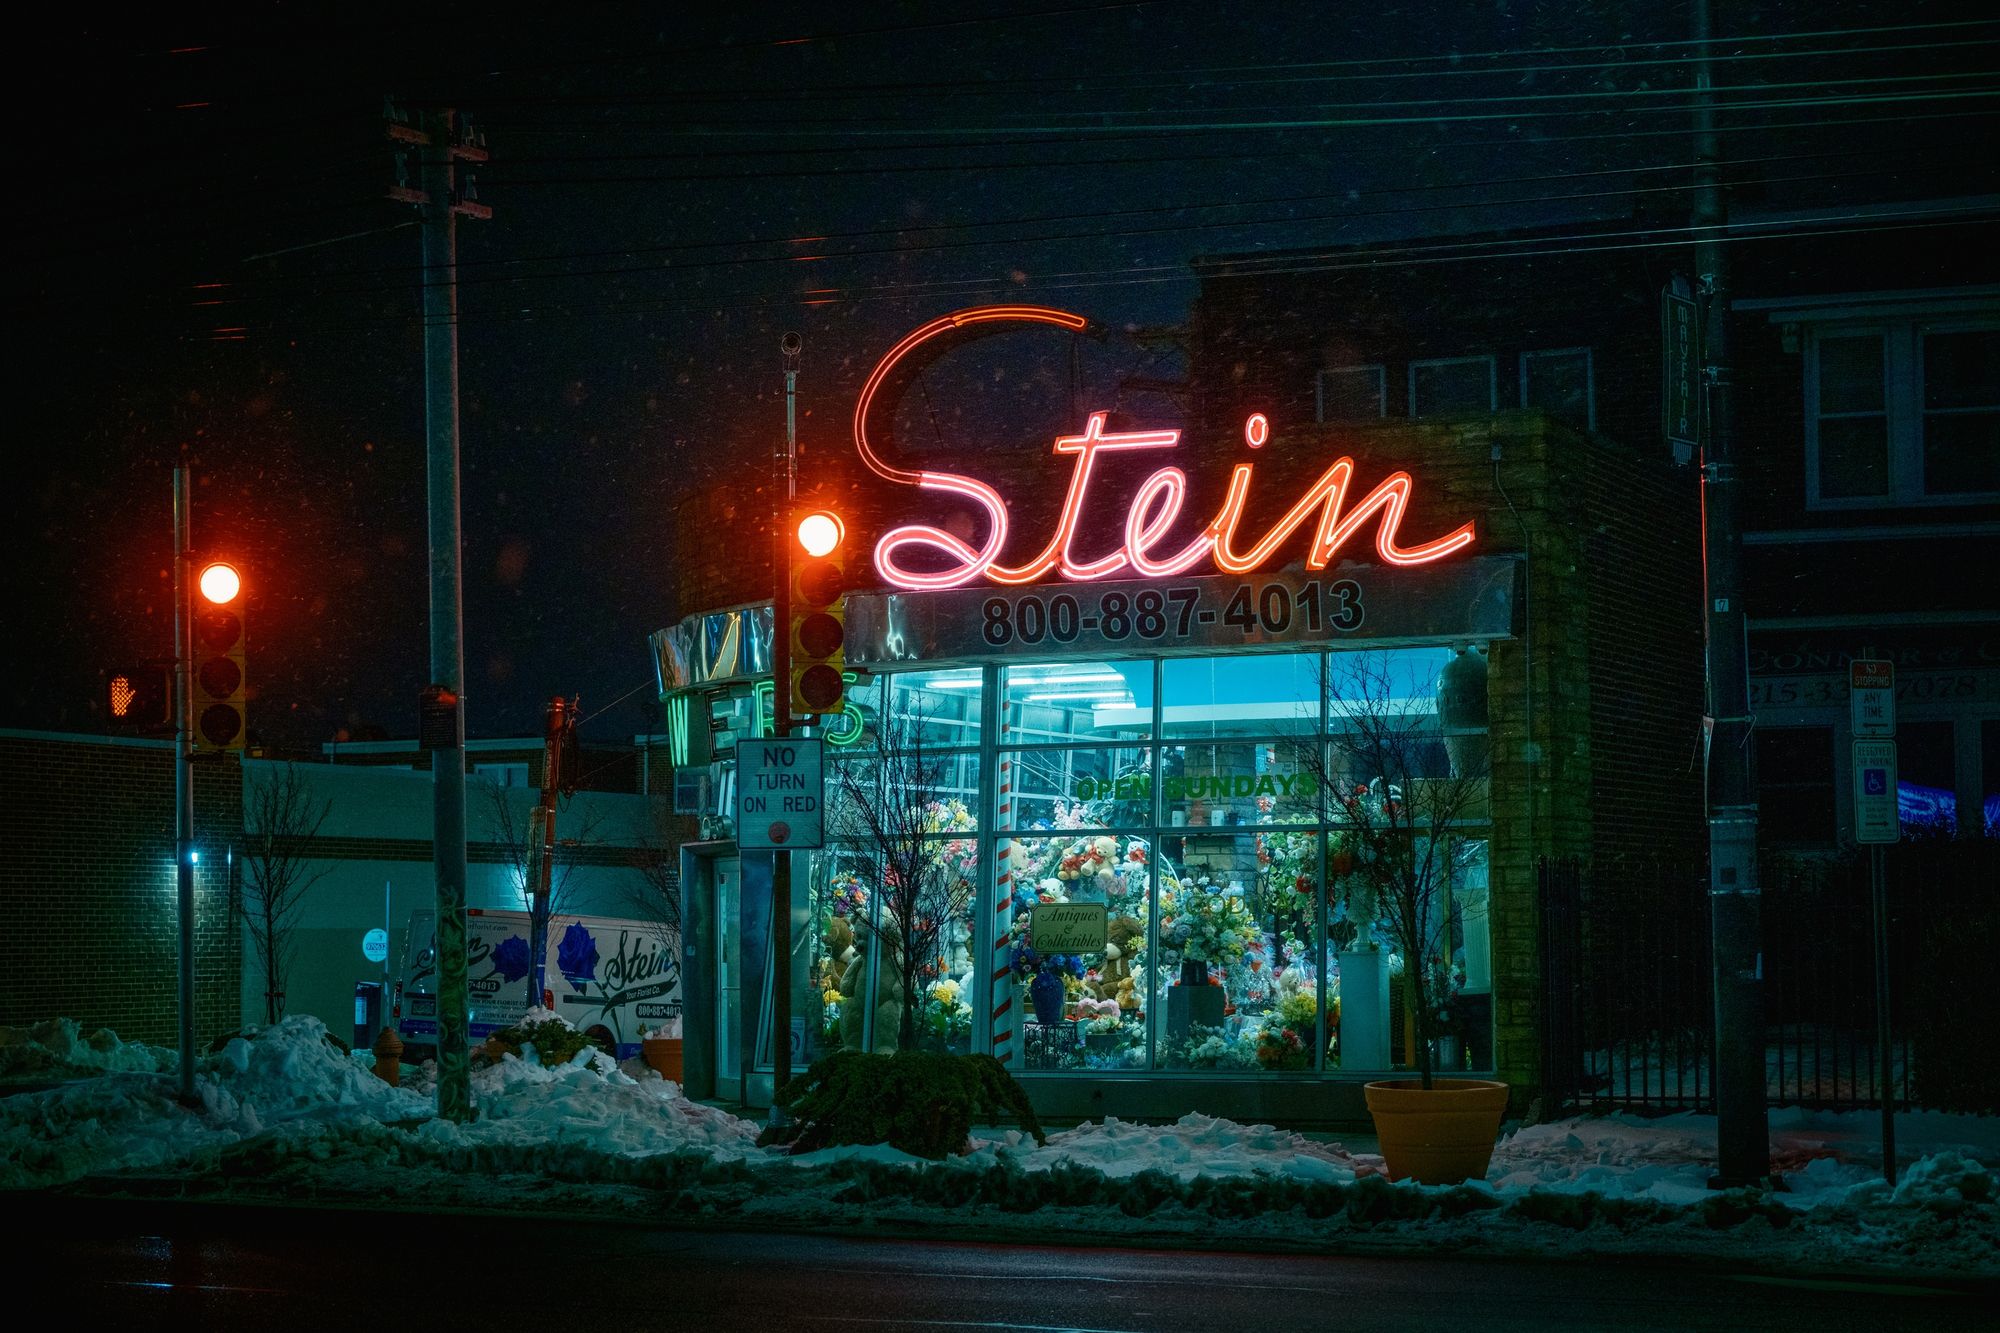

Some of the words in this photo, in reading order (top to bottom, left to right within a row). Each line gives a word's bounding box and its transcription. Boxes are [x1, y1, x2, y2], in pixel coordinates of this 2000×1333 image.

[1677, 304, 1688, 434] MAYFAIR
[854, 303, 1475, 591] Stein
[982, 578, 1366, 647] 800-887-4013
[1863, 691, 1882, 704] ANY
[1863, 706, 1884, 718] TIME
[763, 747, 797, 768] NO
[756, 773, 805, 790] TURN
[1076, 772, 1151, 801] OPEN
[1163, 771, 1319, 799] SUNDAYS
[744, 796, 767, 813] ON
[783, 795, 816, 813] RED
[1039, 907, 1100, 924] Antiques
[1063, 923, 1075, 935] &
[1036, 933, 1103, 950] Collectibles
[604, 930, 682, 992] Stein
